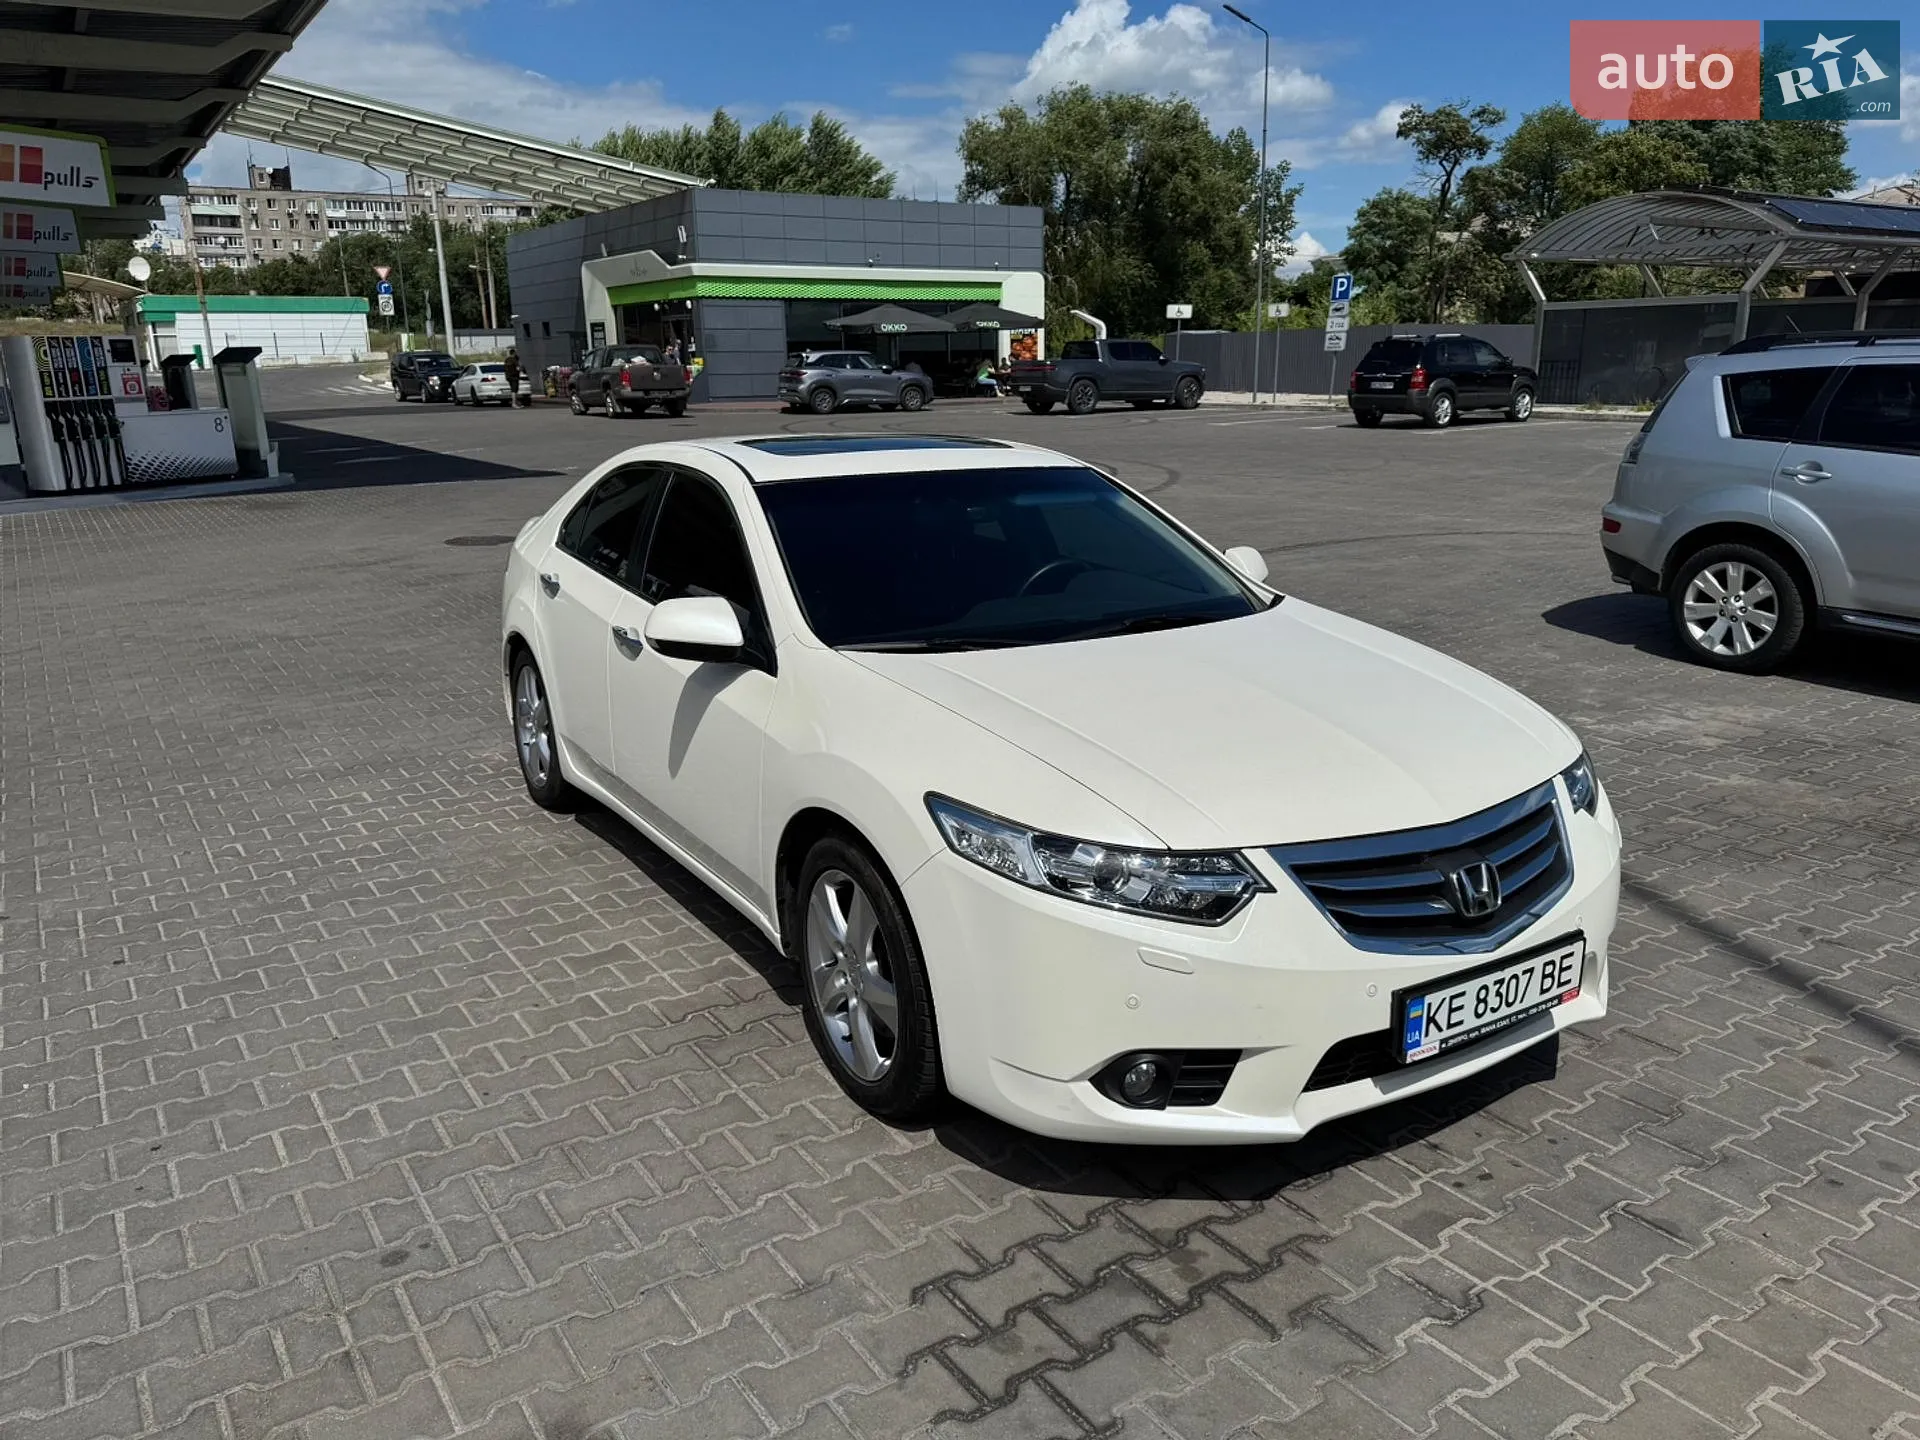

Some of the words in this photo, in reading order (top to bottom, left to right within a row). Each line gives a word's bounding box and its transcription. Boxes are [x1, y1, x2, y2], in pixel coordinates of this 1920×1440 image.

[44, 166, 99, 190] pulls
[33, 226, 72, 244] pulls
[26, 266, 55, 279] pulls
[1336, 278, 1348, 298] P
[881, 323, 908, 332] OKKO
[1425, 991, 1466, 1037] KE
[1474, 967, 1535, 1019] 8307
[1539, 951, 1575, 995] BE
[1407, 1030, 1420, 1043] UA
